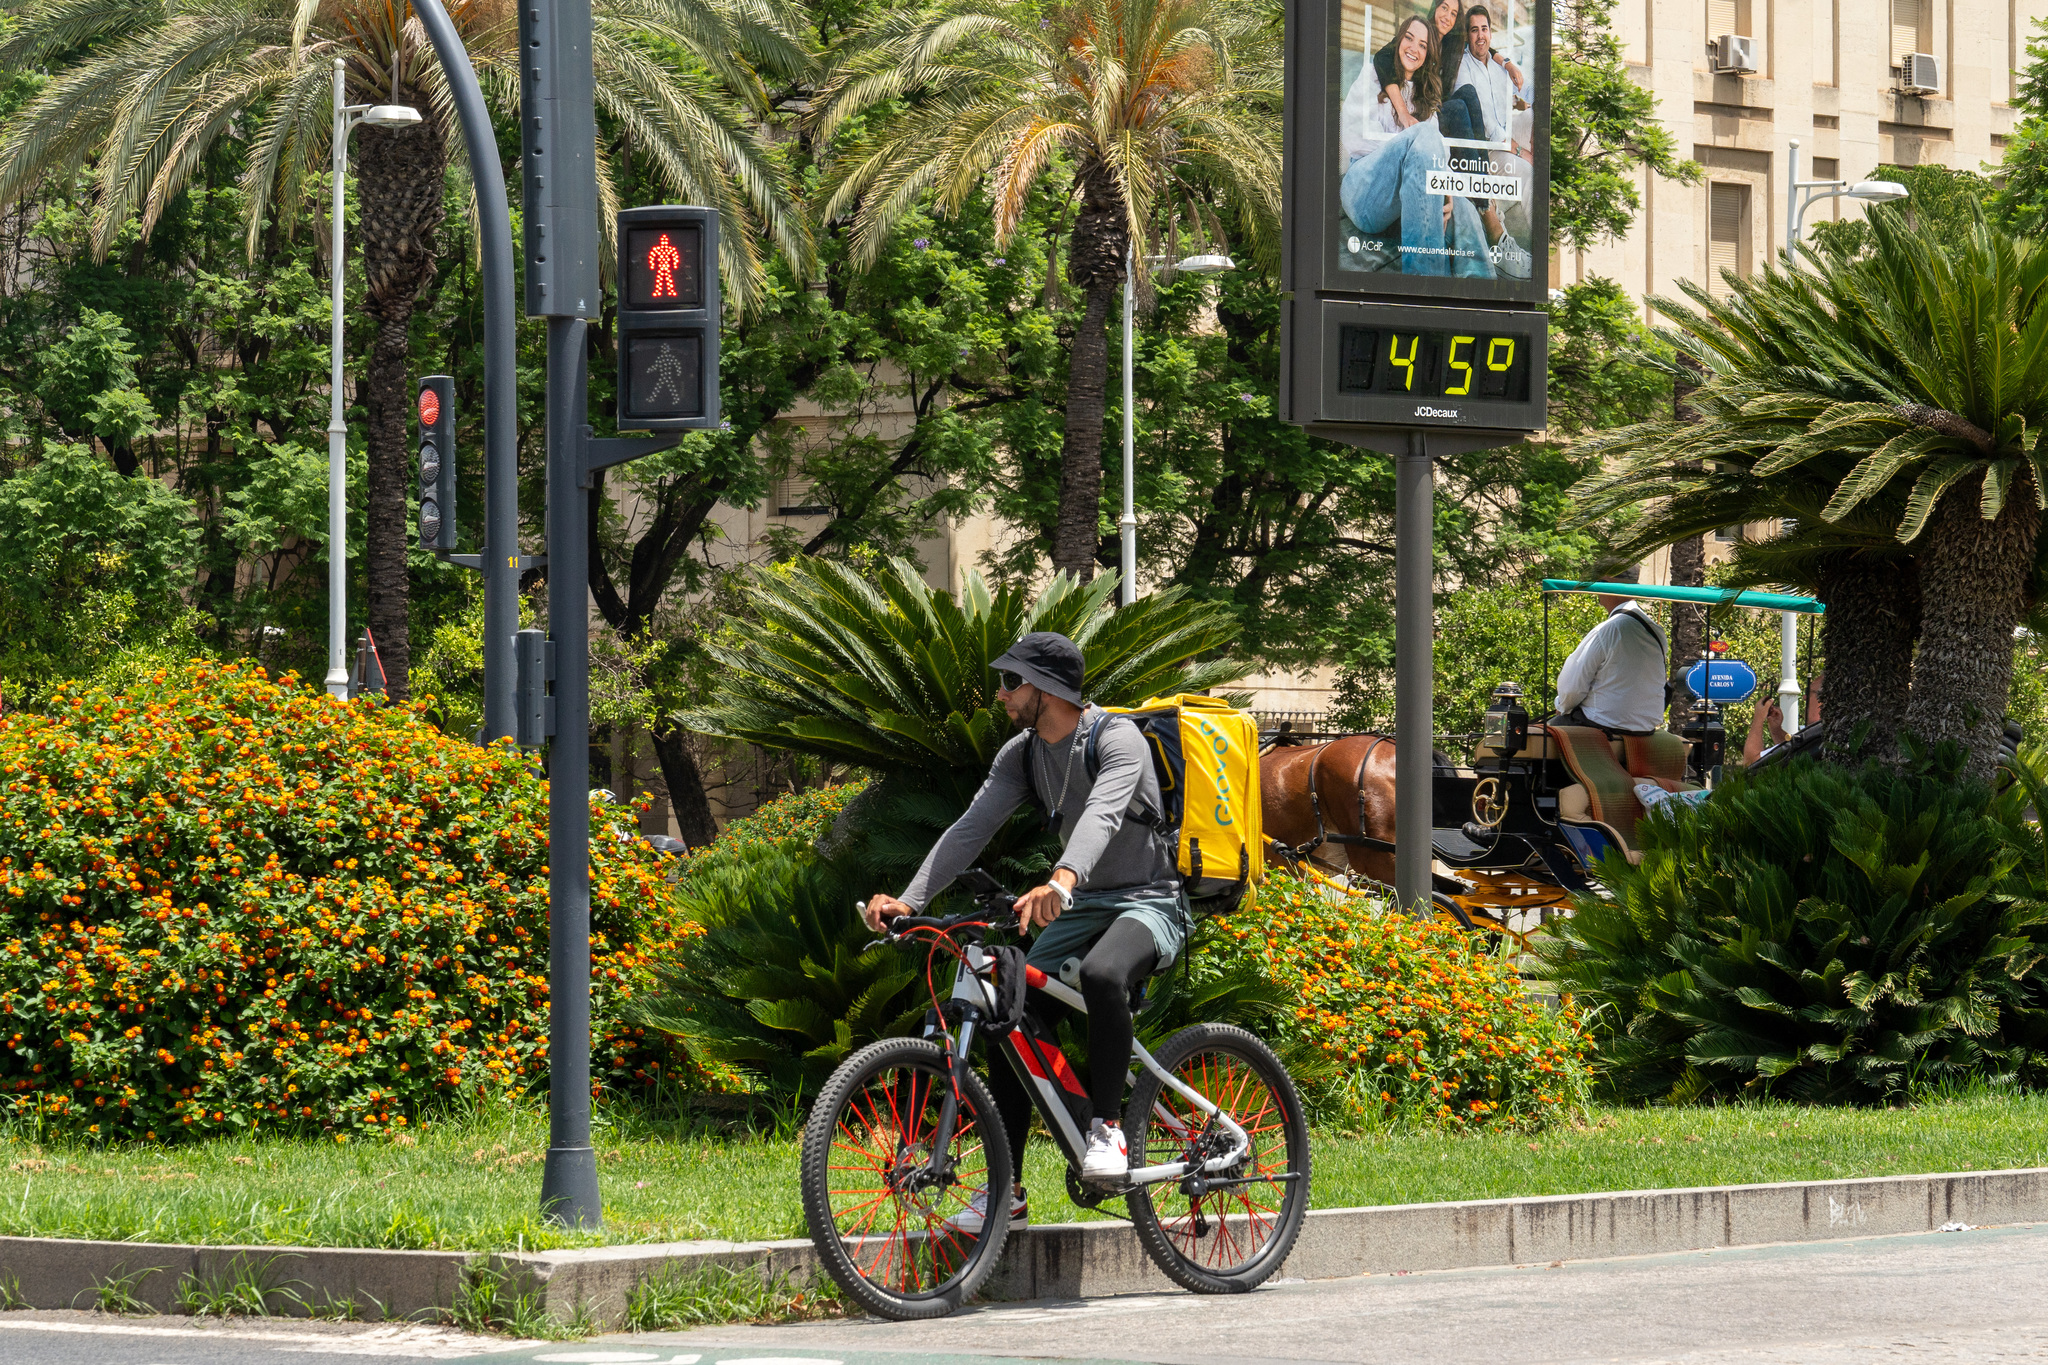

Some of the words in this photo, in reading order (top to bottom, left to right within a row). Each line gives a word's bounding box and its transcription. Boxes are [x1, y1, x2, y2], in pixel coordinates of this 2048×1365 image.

[1432, 153, 1445, 168] tu
[1449, 157, 1499, 173] camino
[1504, 158, 1516, 174] al
[1430, 175, 1464, 191] éxito
[1469, 176, 1518, 196] laboral
[1361, 240, 1384, 252] ACdP
[1397, 245, 1475, 257] www.ceuandalucia.es
[1504, 251, 1522, 262] CEU
[1414, 406, 1458, 418] JCDecaux
[507, 556, 518, 568] 11
